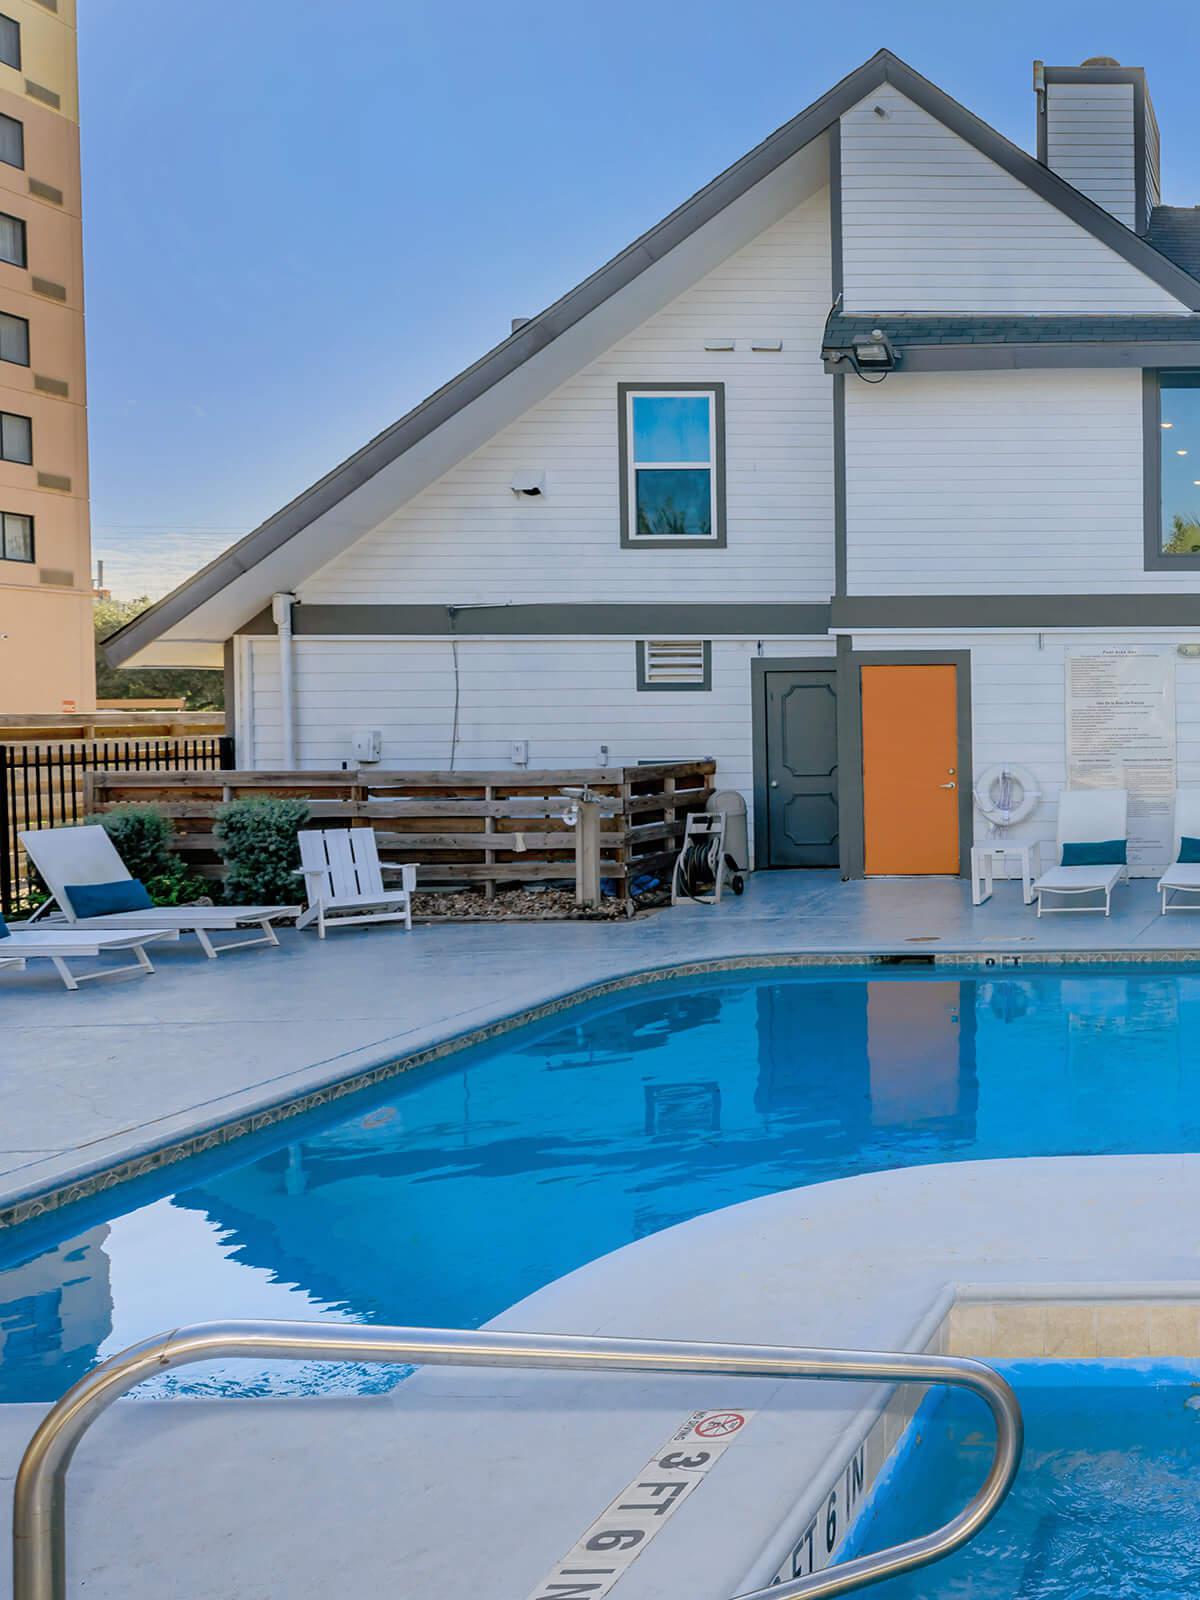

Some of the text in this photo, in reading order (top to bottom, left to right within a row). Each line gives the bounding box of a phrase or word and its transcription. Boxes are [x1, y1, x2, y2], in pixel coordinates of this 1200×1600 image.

[534, 1451, 711, 1600] 3 FT 6 IN
[826, 1491, 836, 1553] 6
[846, 1446, 864, 1522] IN
